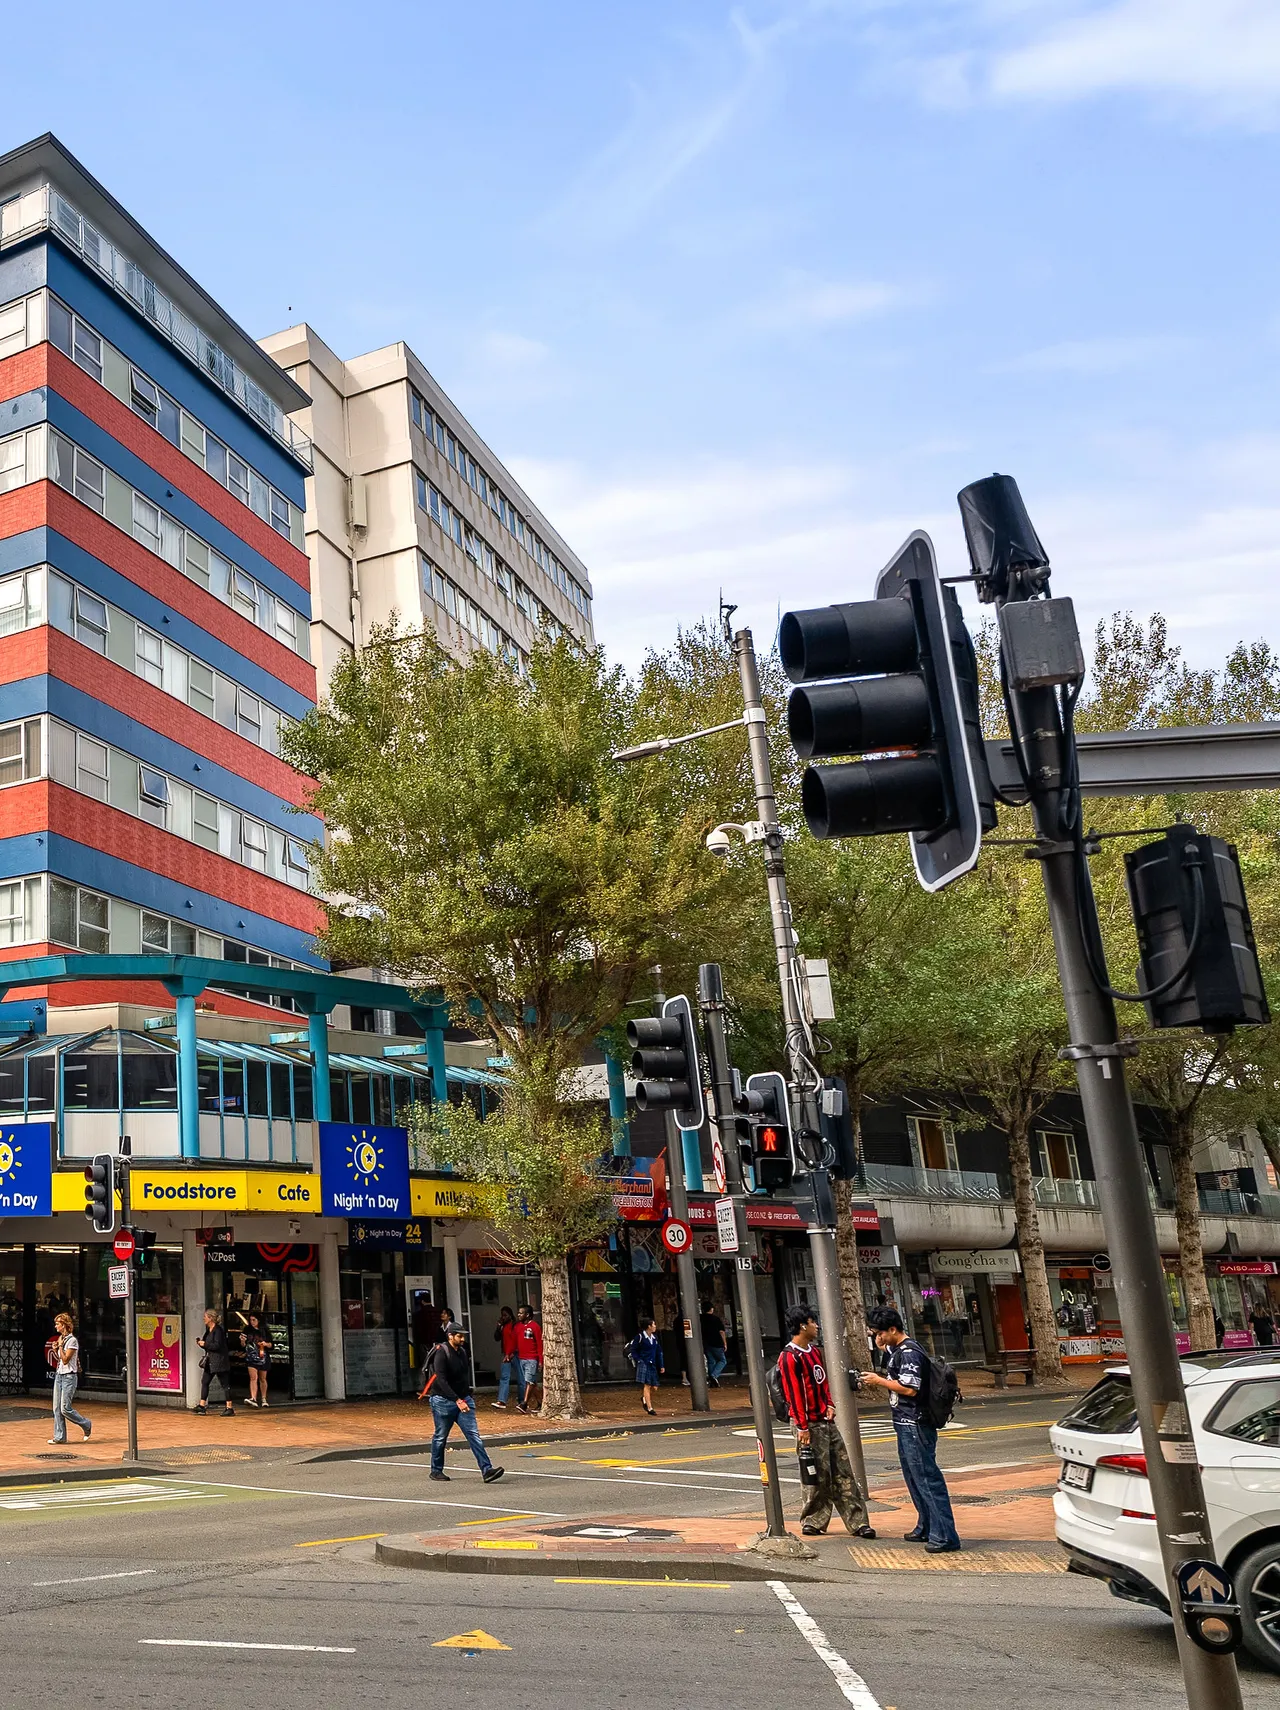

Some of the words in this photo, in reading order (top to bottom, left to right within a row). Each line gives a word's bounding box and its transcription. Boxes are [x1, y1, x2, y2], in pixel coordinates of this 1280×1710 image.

[1097, 1058, 1111, 1079] 1
[143, 1182, 236, 1199] Foodstore
[277, 1184, 310, 1201] Cafe
[13, 1193, 38, 1210] Day
[333, 1192, 363, 1211] Night
[378, 1194, 399, 1212] Day
[369, 1230, 384, 1239] Night
[391, 1230, 402, 1239] Day
[405, 1224, 422, 1238] 24
[669, 1229, 684, 1243] 30
[207, 1251, 236, 1262] NZPost
[738, 1258, 751, 1269] 15
[937, 1255, 972, 1270] Gong
[973, 1255, 997, 1266] cha
[155, 1348, 165, 1358] $3
[151, 1358, 170, 1369] PIES
